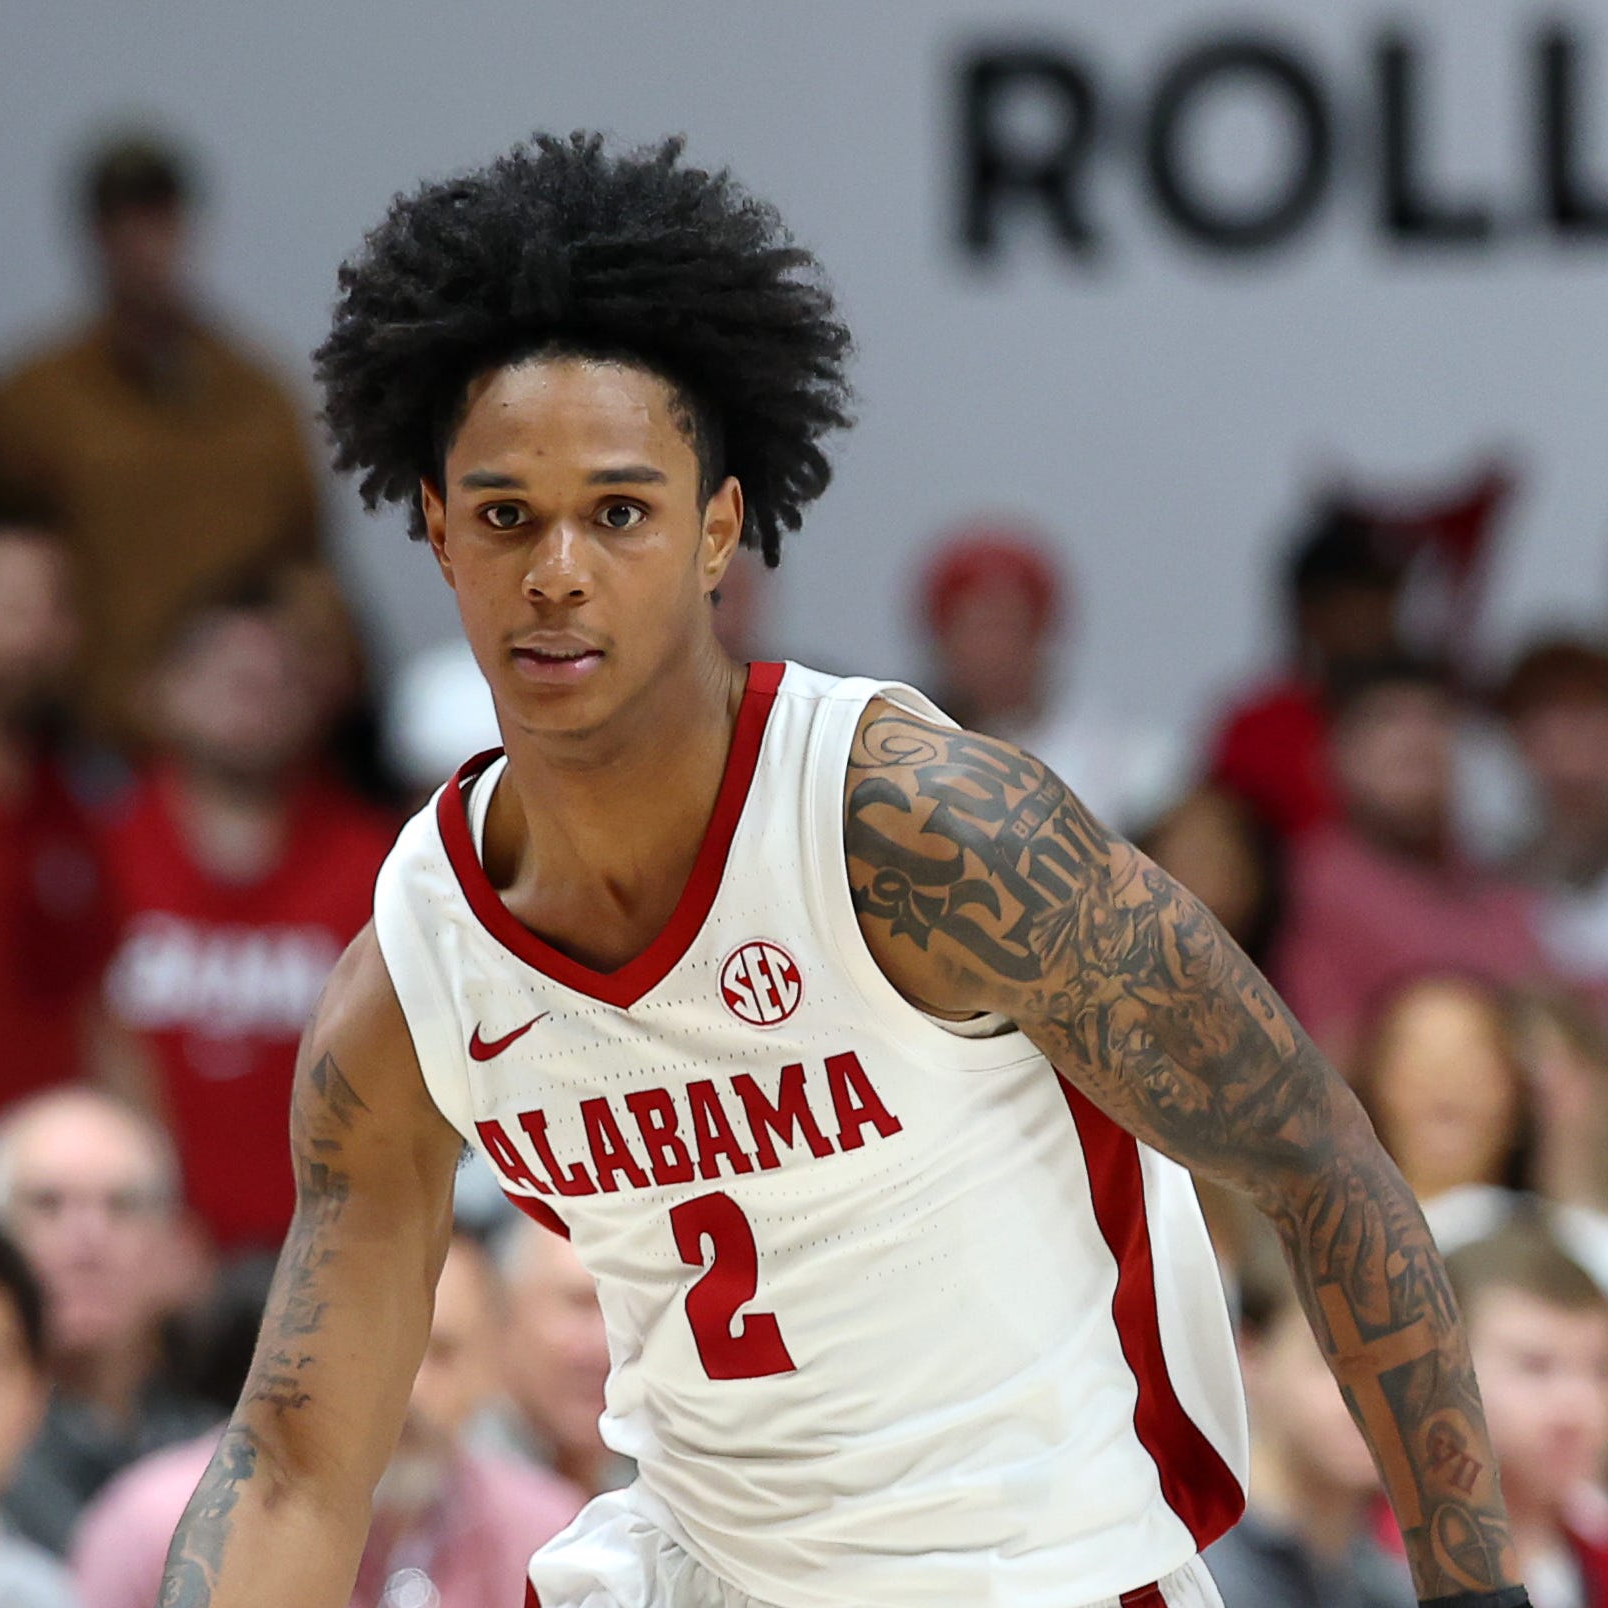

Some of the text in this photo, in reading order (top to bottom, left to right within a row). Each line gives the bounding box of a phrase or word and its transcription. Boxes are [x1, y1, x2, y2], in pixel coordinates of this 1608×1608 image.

[721, 943, 801, 1023] SEC
[474, 1050, 904, 1197] ALABAMA
[668, 1190, 798, 1382] 2
